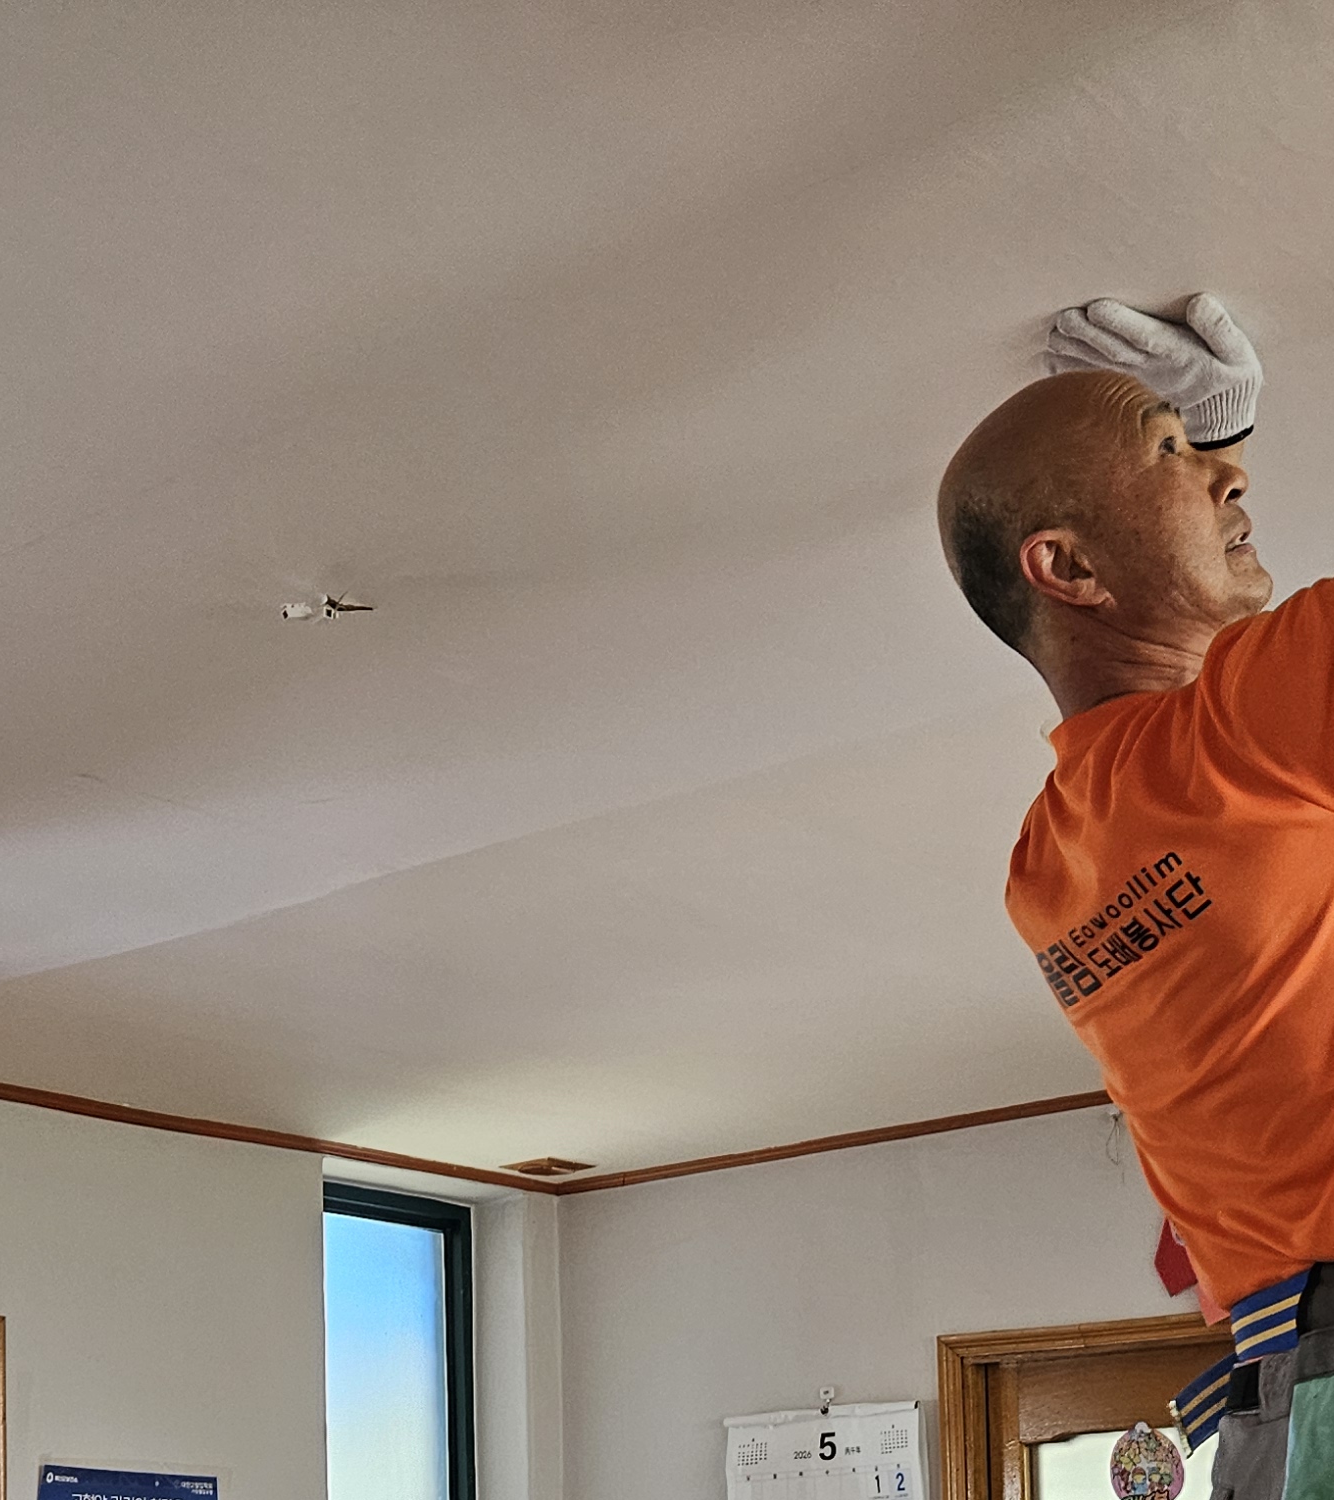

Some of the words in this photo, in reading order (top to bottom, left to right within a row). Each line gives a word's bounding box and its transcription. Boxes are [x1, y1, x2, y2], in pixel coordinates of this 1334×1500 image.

[1068, 851, 1183, 949] Eowoollim
[1087, 871, 1213, 979] 도배봉사단
[793, 1451, 813, 1460] 2026
[818, 1431, 837, 1461] 5
[875, 1475, 881, 1493] 1
[896, 1472, 905, 1490] 2
